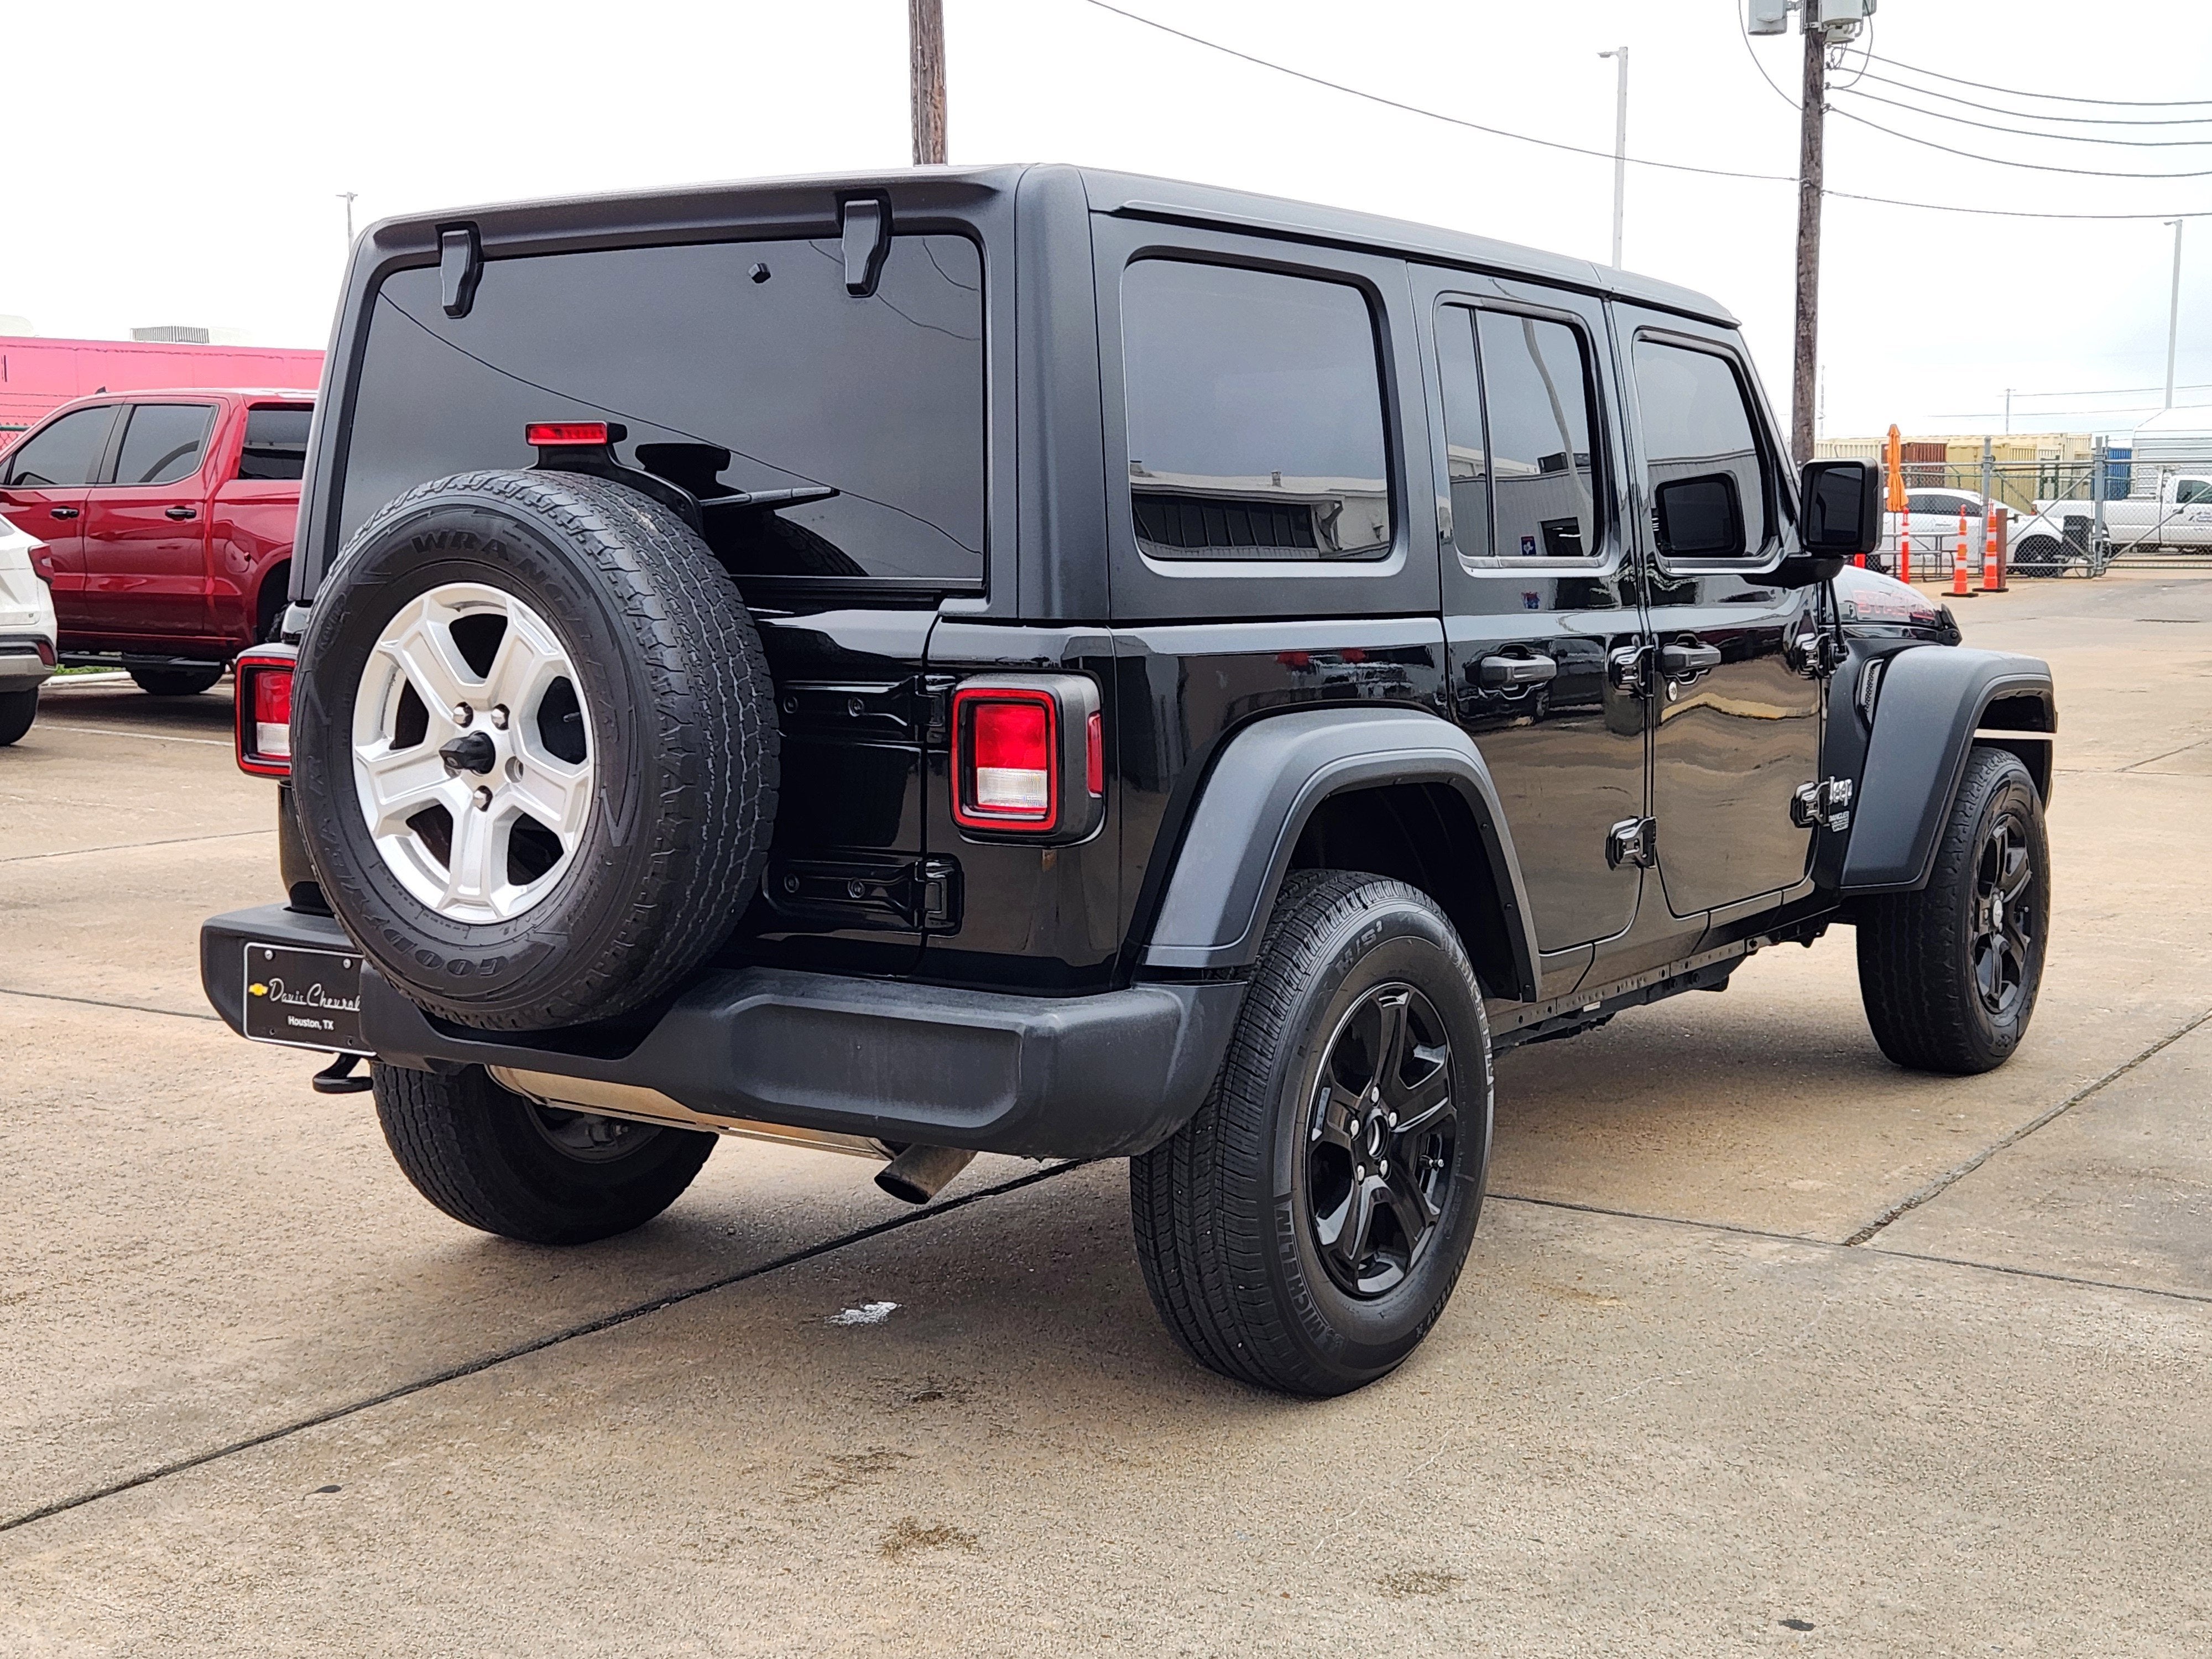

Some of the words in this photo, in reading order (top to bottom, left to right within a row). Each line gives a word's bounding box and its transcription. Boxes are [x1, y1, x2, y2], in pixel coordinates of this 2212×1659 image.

[306, 755, 508, 978] GOODYEAR
[269, 978, 304, 1005] Davis
[306, 983, 361, 1012] Chevrol
[288, 1015, 322, 1031] Houston,
[322, 1019, 334, 1030] TX
[1275, 1208, 1326, 1339] MICHELIN
